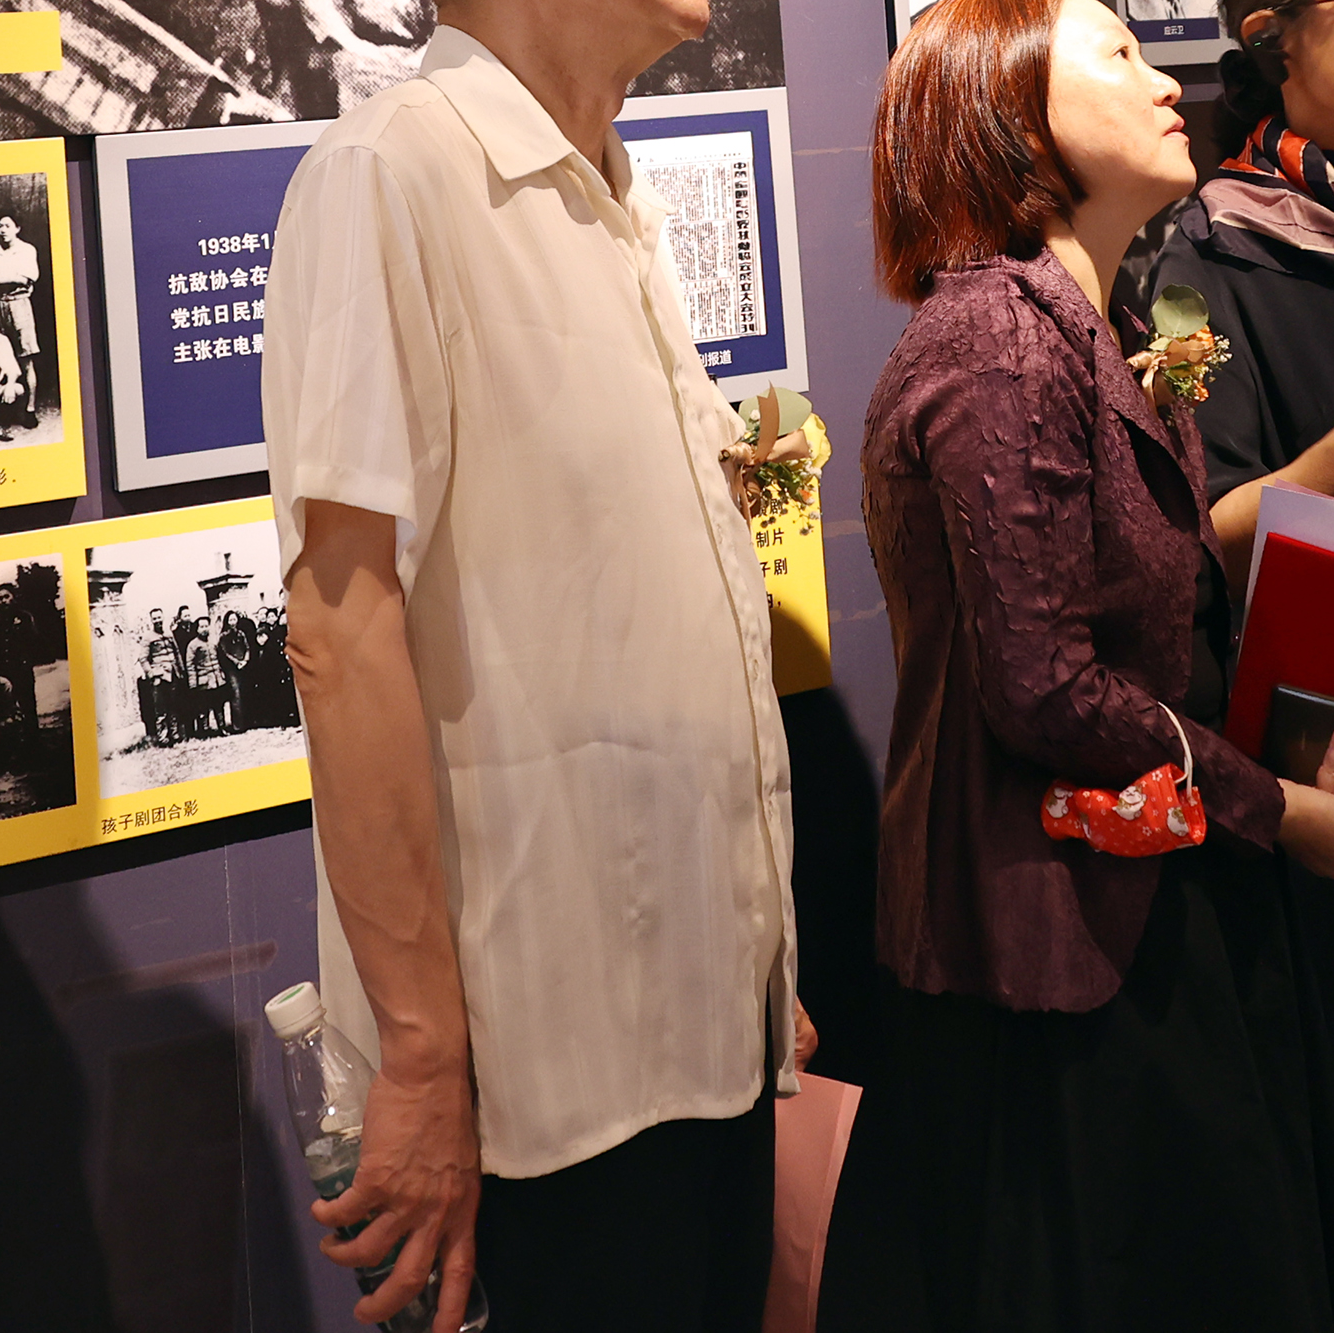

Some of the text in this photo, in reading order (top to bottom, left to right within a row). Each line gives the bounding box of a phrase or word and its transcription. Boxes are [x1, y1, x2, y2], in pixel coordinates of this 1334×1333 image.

[197, 231, 278, 256] 1938年1
[168, 265, 268, 296] 抗敌协会在
[755, 528, 785, 548] 制片
[101, 799, 199, 835] 孩子剧团合影
